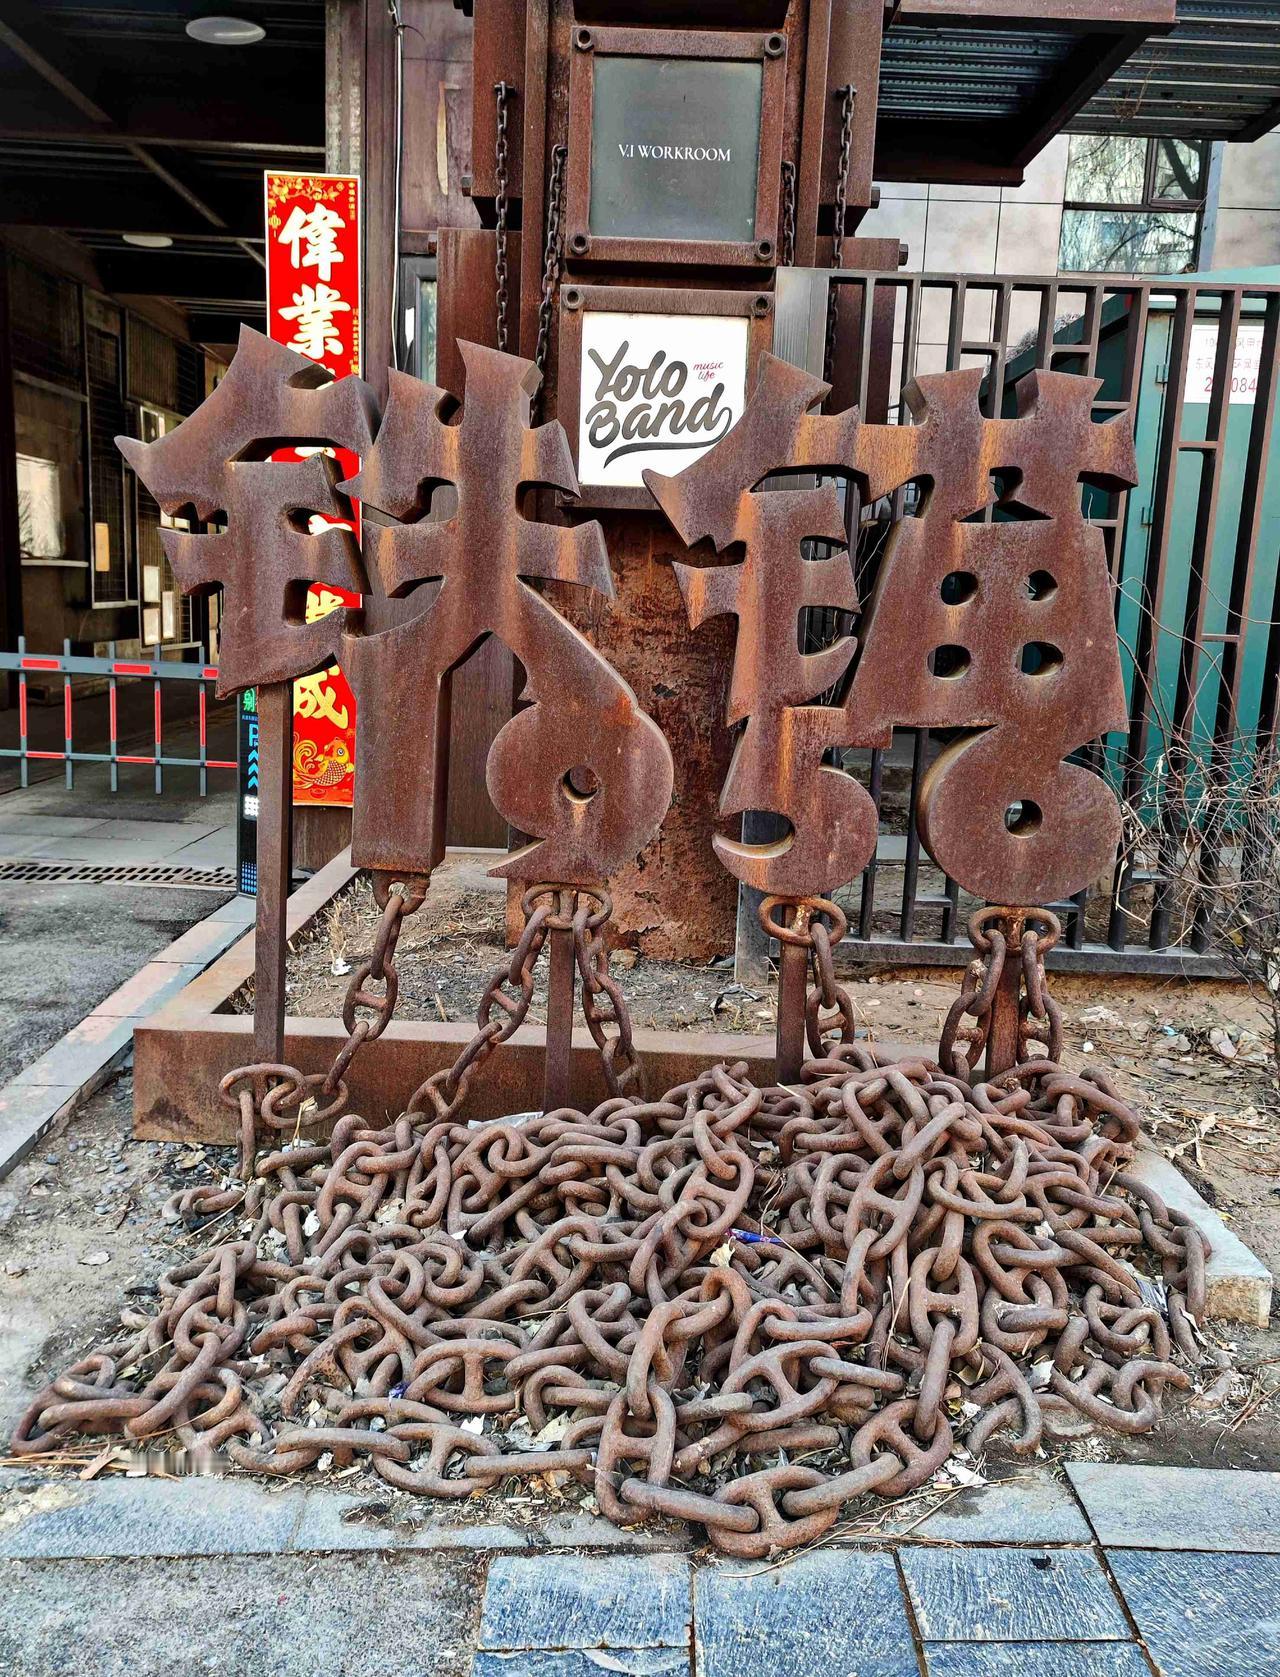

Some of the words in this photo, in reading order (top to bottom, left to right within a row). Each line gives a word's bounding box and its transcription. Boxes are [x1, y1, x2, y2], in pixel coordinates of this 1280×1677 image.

[617, 143, 635, 159] V.I
[637, 144, 732, 162] WORKROOM
[587, 340, 688, 402] Yolo
[692, 360, 725, 372] music
[697, 371, 716, 383] life
[585, 382, 732, 449] Band
